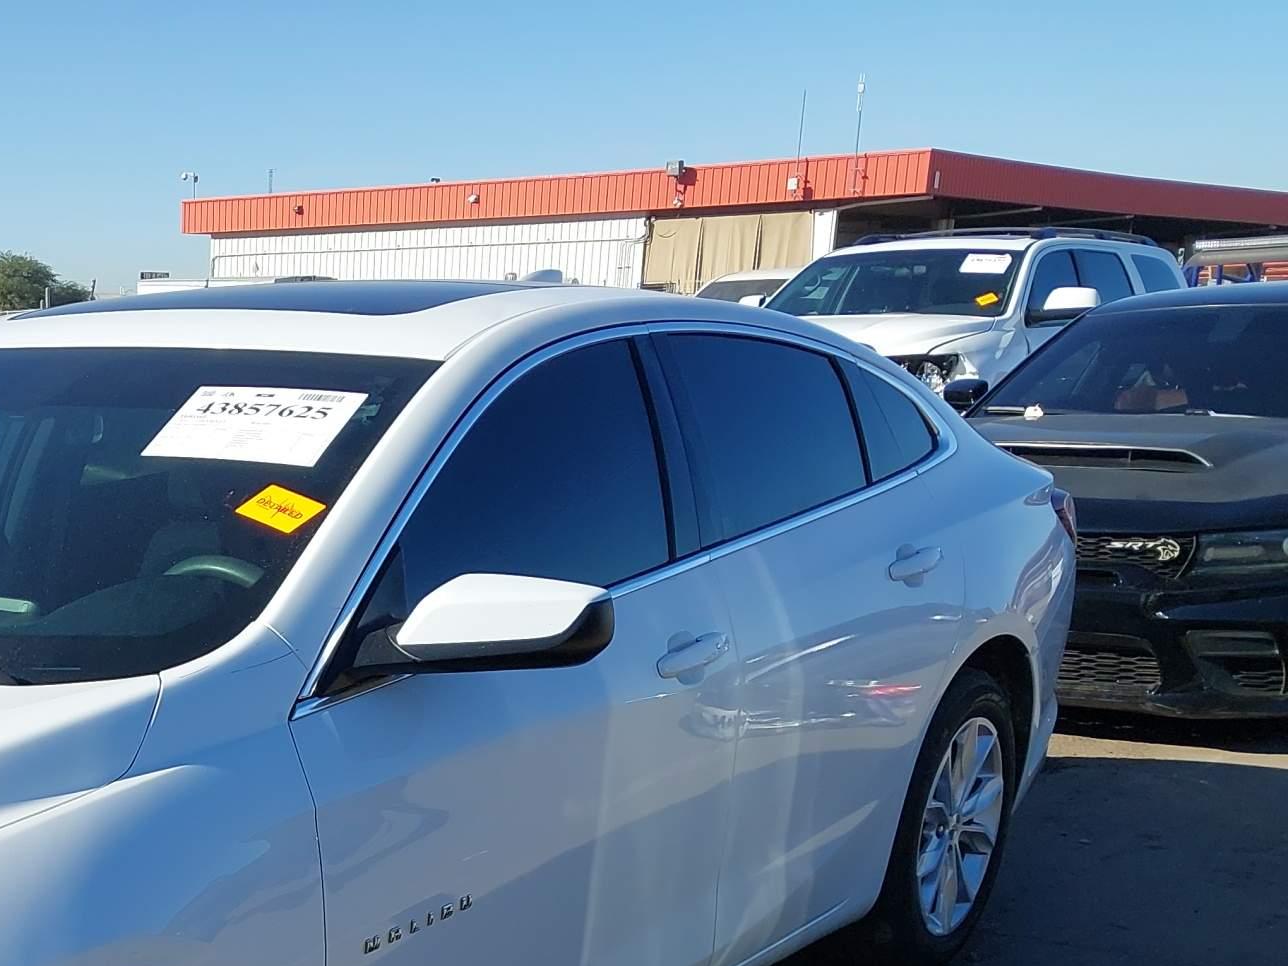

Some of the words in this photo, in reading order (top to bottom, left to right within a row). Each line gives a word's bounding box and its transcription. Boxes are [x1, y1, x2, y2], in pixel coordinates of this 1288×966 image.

[195, 401, 334, 421] 43857625
[1105, 541, 1161, 550] SRT
[364, 894, 473, 954] MALIBU
